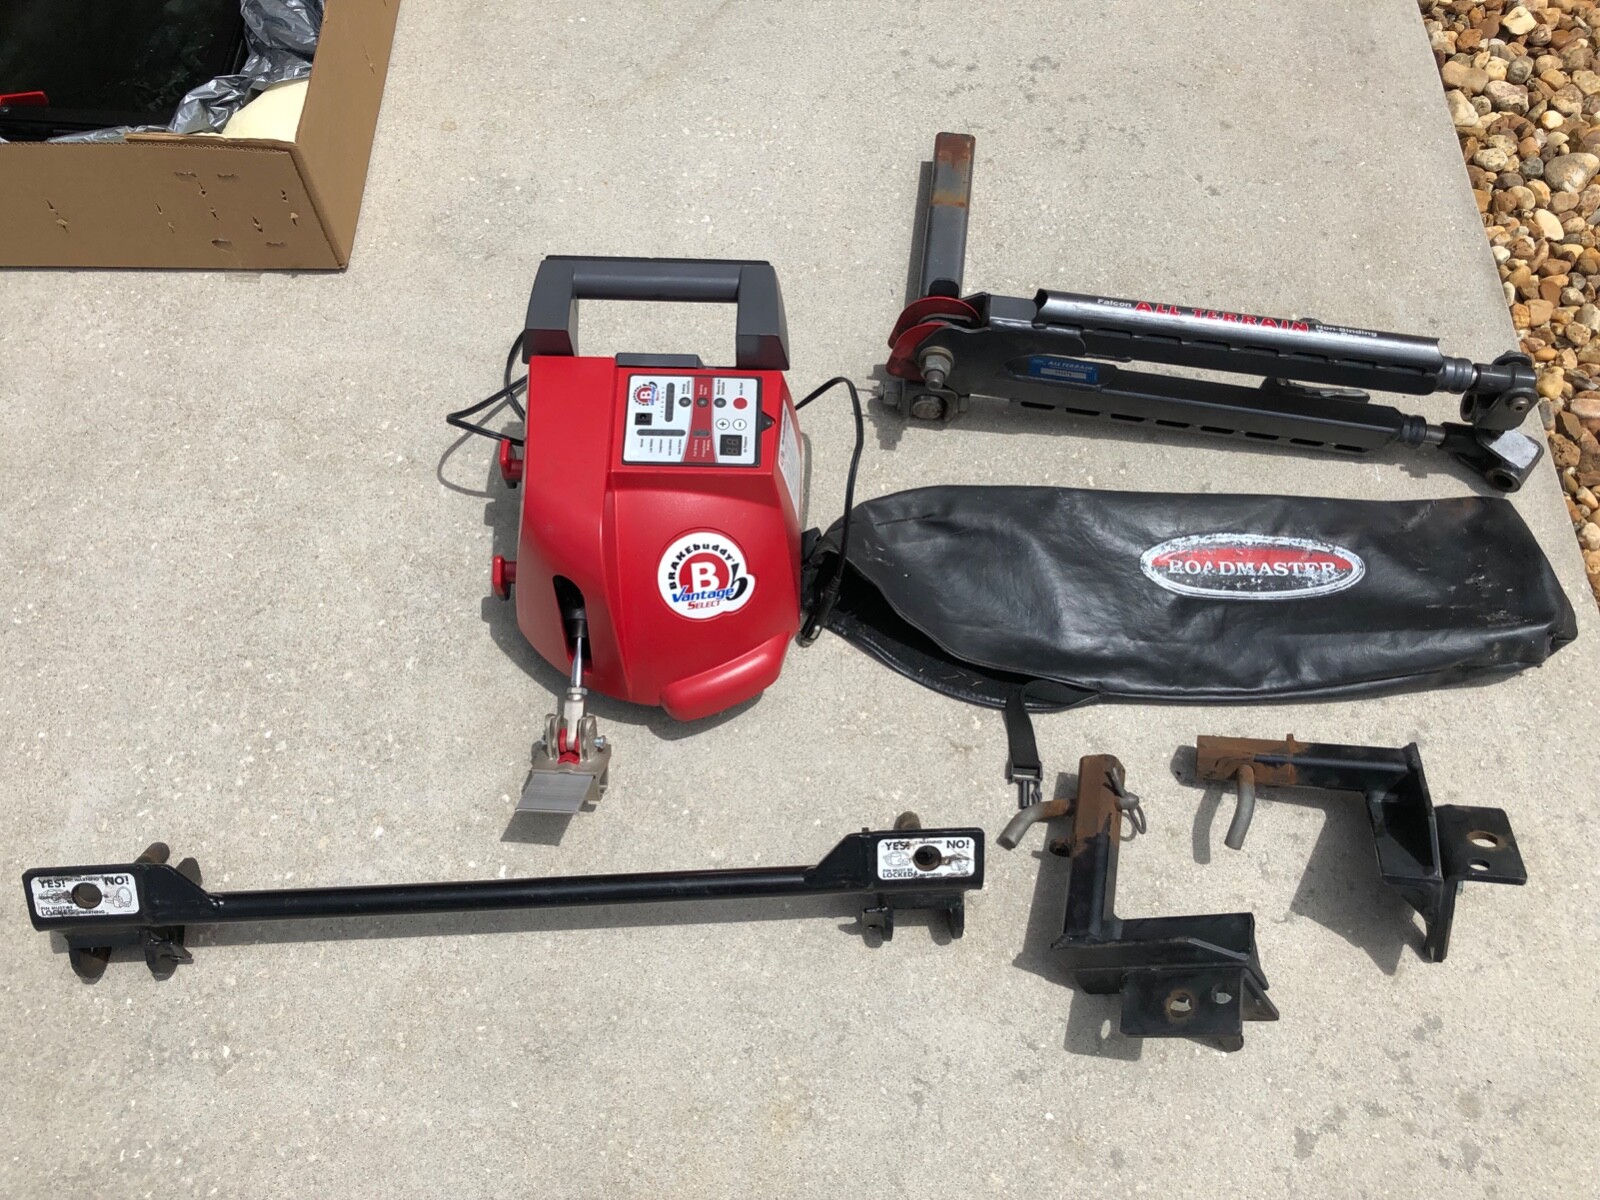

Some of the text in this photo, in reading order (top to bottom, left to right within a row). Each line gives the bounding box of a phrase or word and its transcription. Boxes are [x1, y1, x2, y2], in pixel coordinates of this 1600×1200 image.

[1097, 298, 1309, 333] Falcon ALL TERRAIN
[1315, 324, 1378, 338] Non-Binding
[668, 543, 733, 590] BRAKEbuddy
[1168, 559, 1337, 577] ROADMASTER
[672, 585, 735, 603] Vantage
[687, 600, 721, 610] SELECT
[885, 841, 910, 851] YES!
[946, 840, 970, 849] NO!
[38, 879, 66, 889] YES!
[104, 875, 129, 886] NO!
